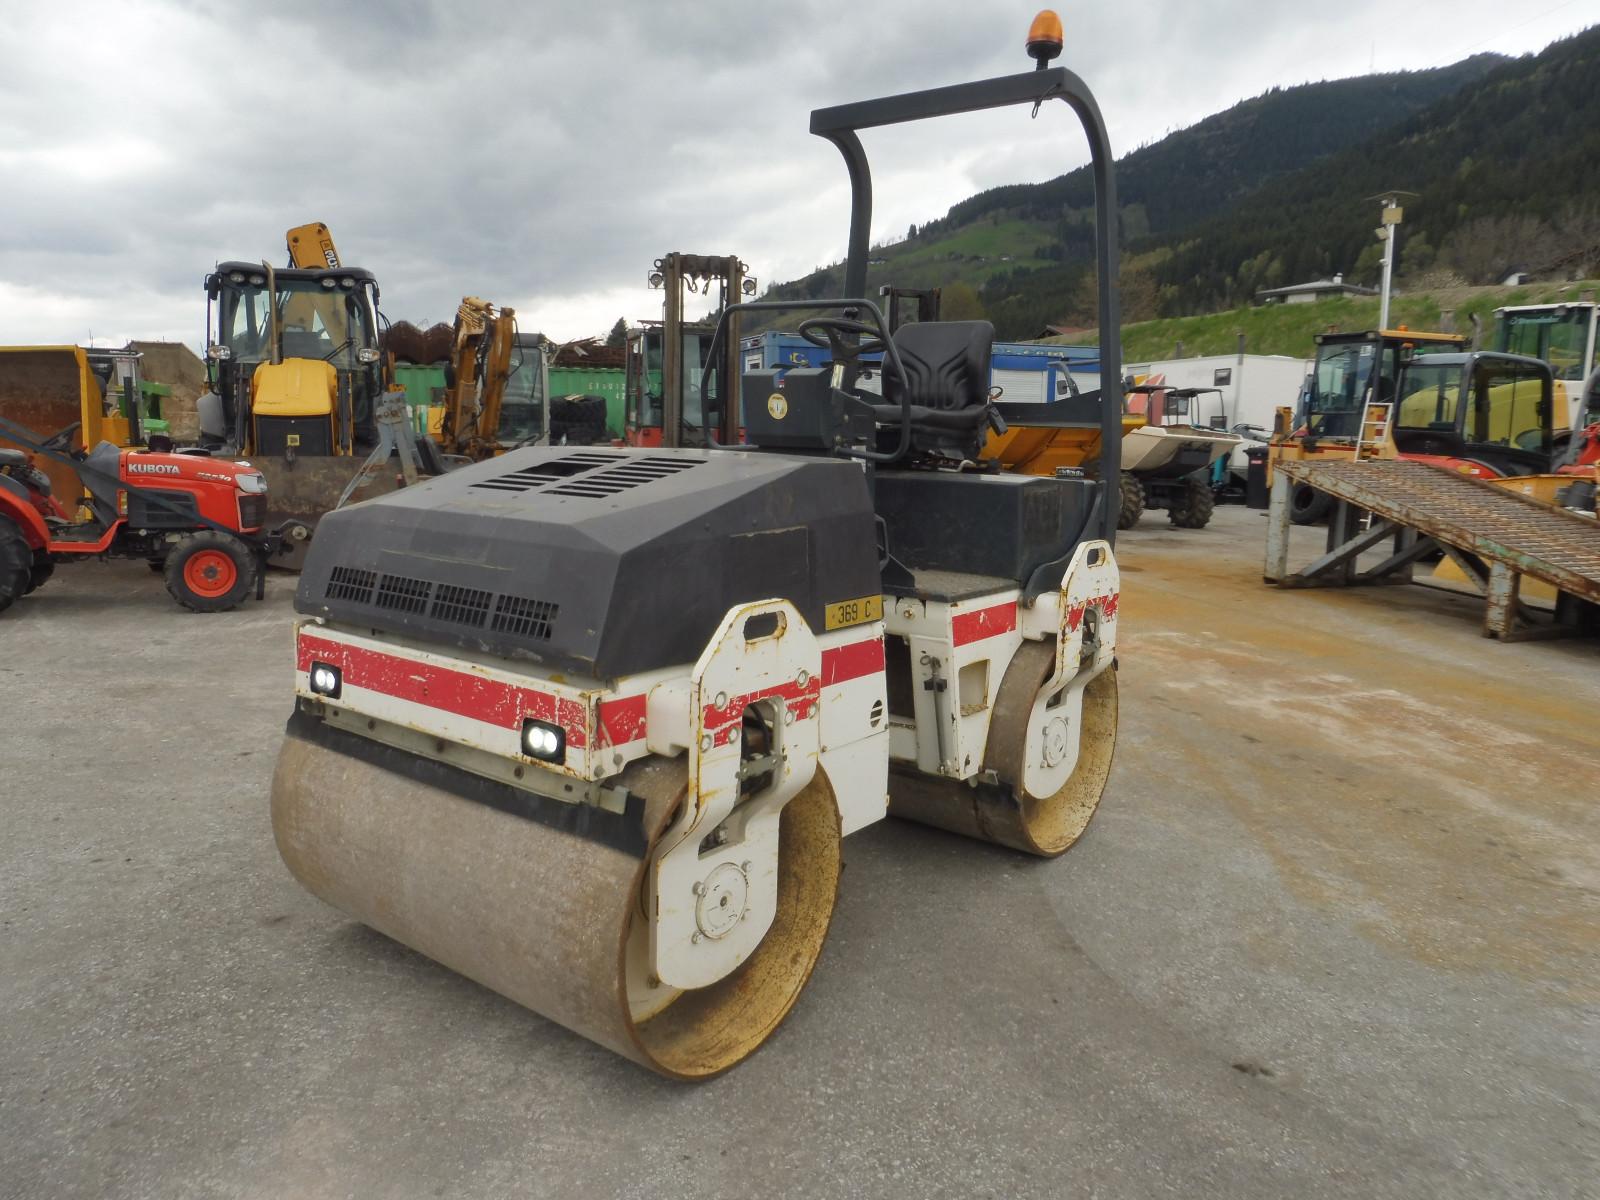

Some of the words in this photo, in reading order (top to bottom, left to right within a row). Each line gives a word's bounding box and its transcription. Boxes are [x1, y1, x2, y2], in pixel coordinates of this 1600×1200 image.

[128, 463, 180, 475] KUBOTA
[838, 602, 858, 624] 369
[864, 600, 871, 618] C
